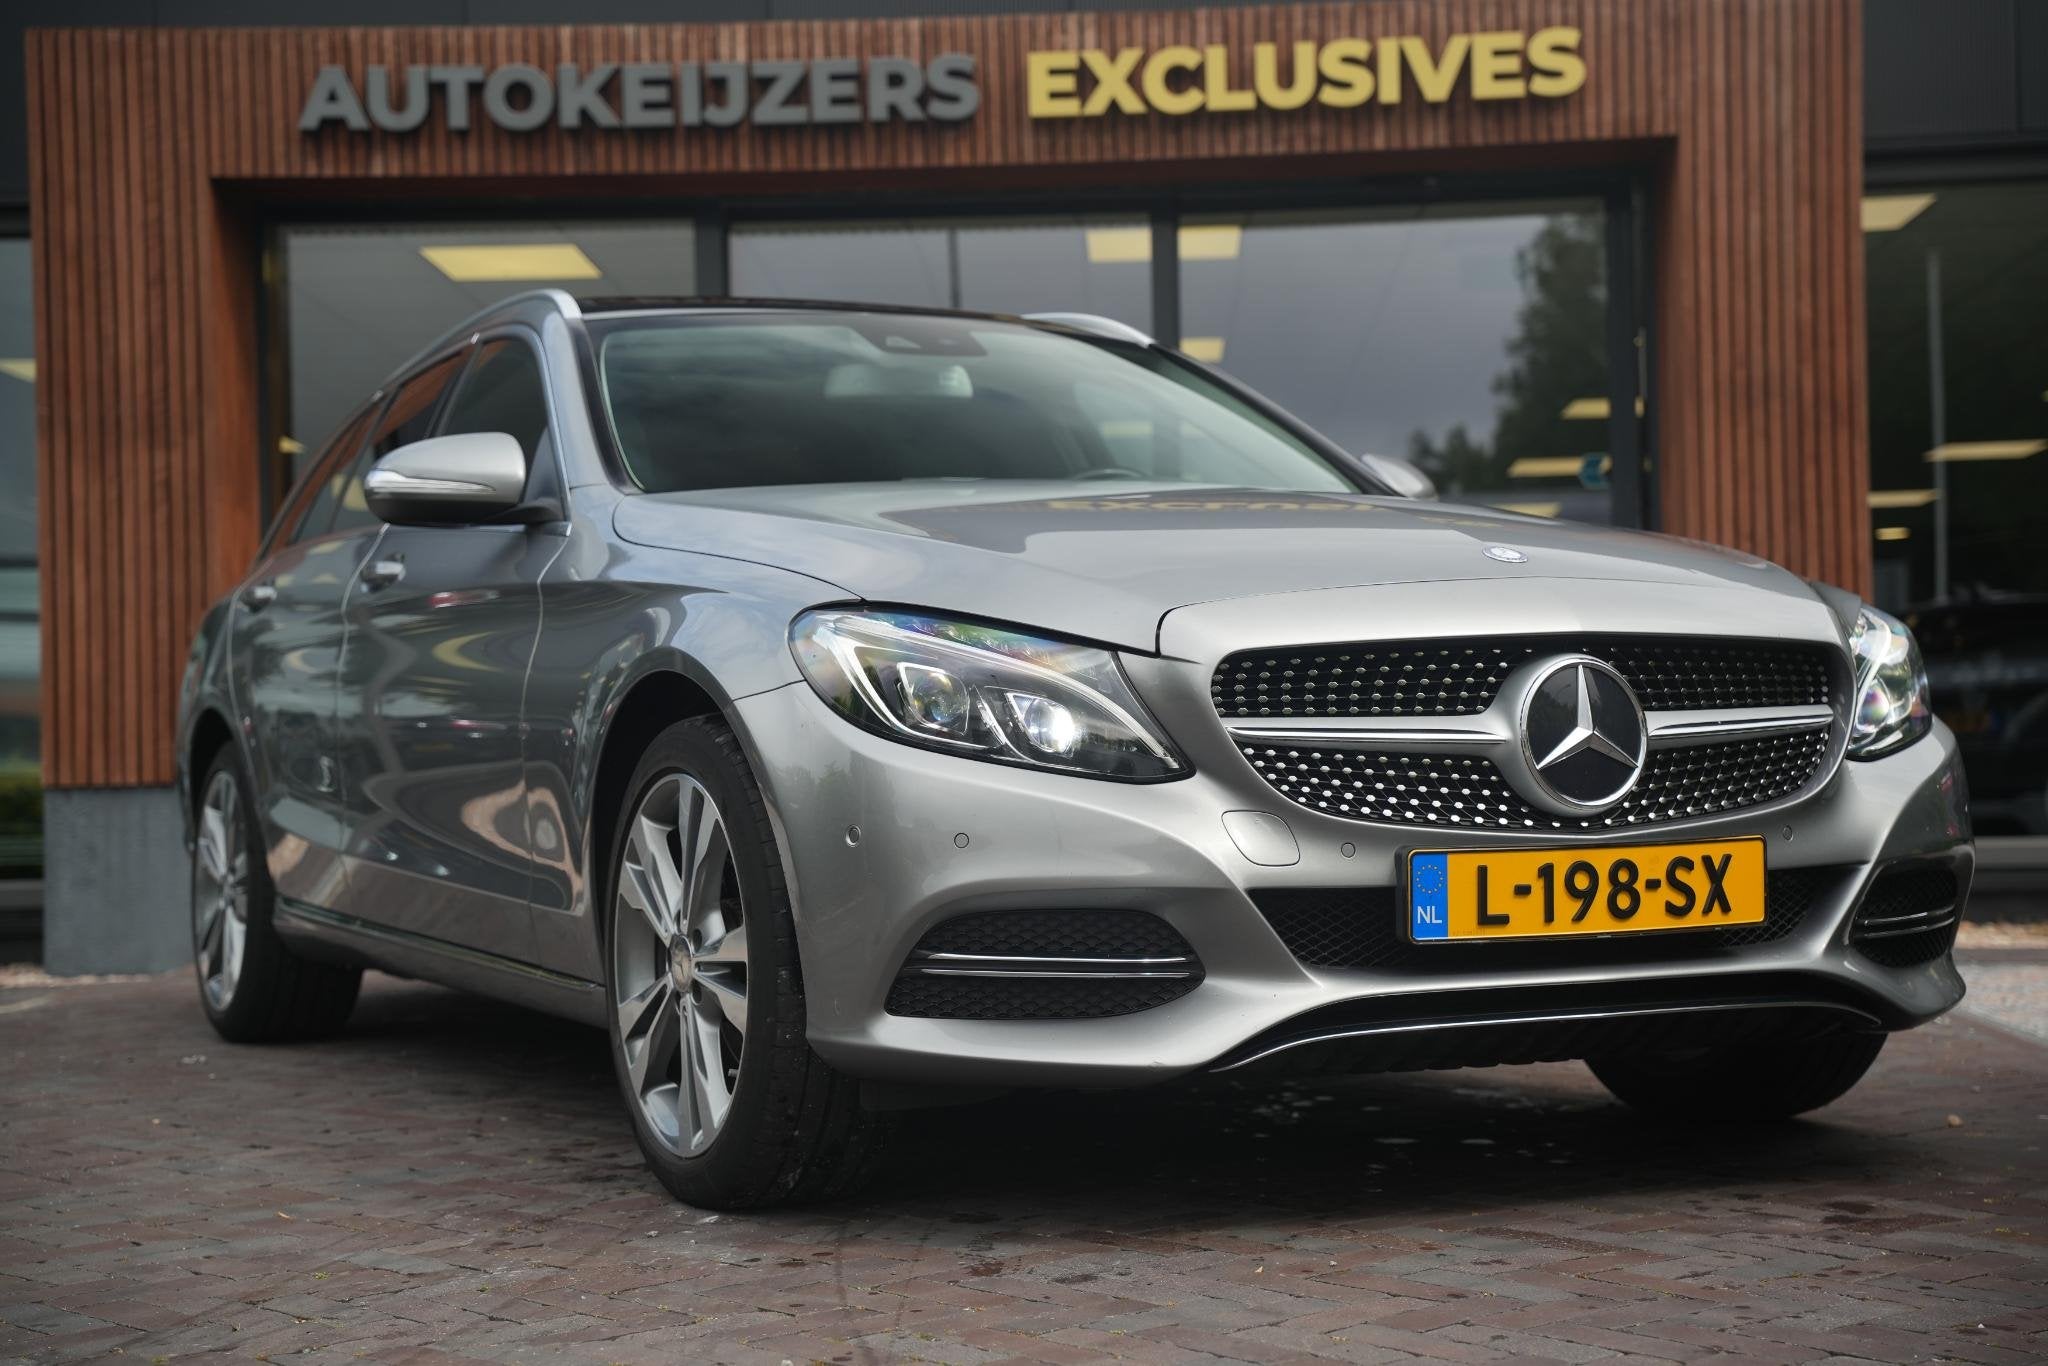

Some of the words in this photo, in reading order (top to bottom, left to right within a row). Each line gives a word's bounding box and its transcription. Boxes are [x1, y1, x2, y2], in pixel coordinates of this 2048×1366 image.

[298, 53, 981, 133] AUTOKEIJZERS
[1027, 26, 1588, 119] EXCLUSIVES
[1417, 905, 1443, 924] NL
[1477, 853, 1732, 926] L-198-SX
